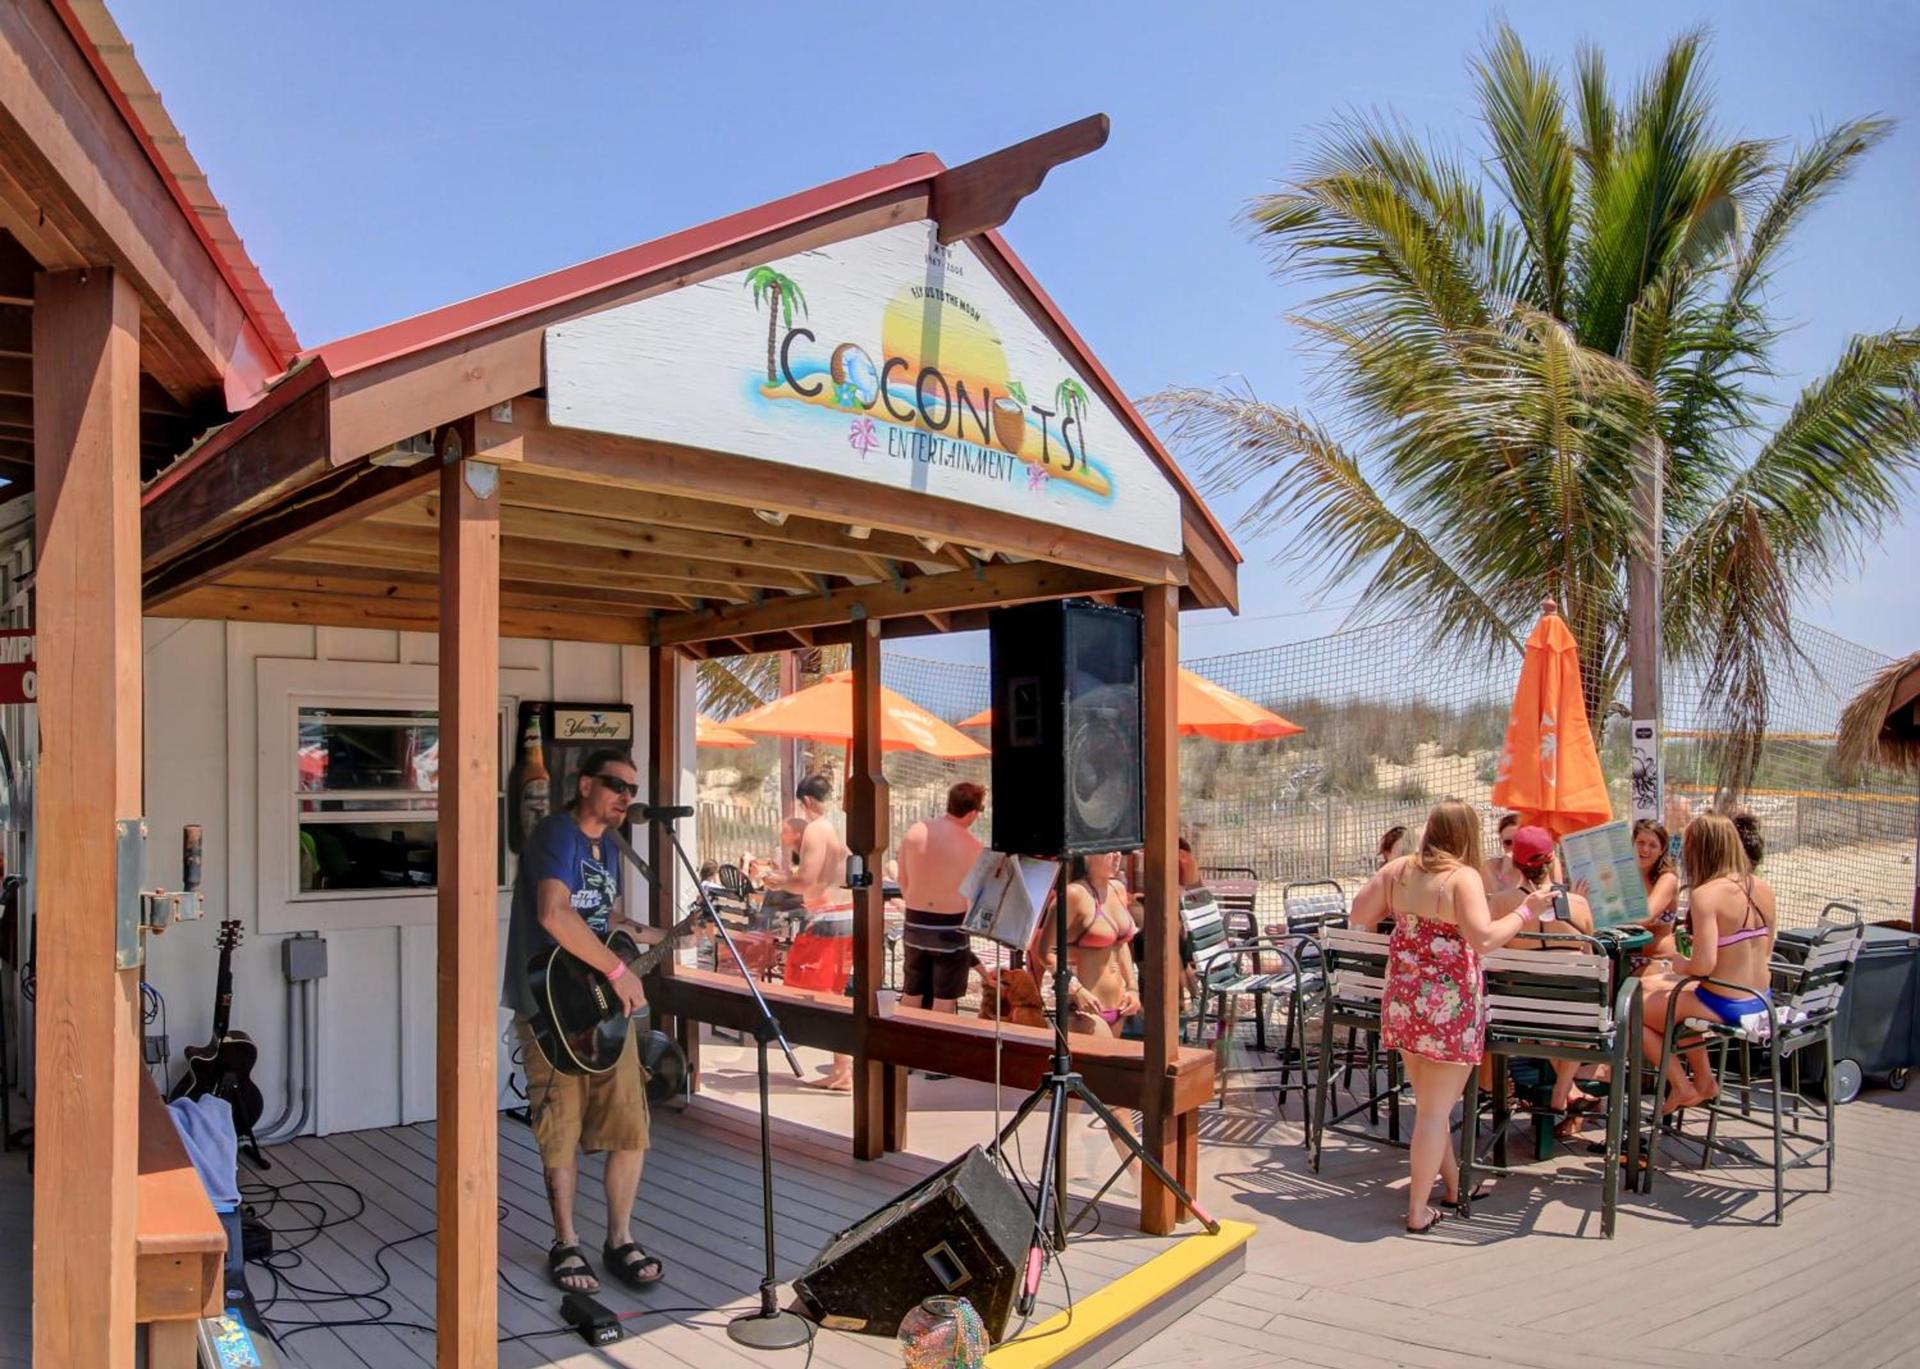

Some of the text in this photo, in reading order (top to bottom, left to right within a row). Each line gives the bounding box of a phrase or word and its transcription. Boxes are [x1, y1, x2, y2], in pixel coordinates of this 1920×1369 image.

[946, 293, 958, 307] THE
[780, 328, 1075, 472] COCONUTS
[888, 427, 1015, 483] ENTERTAINMENT
[563, 718, 620, 737] Yuengling
